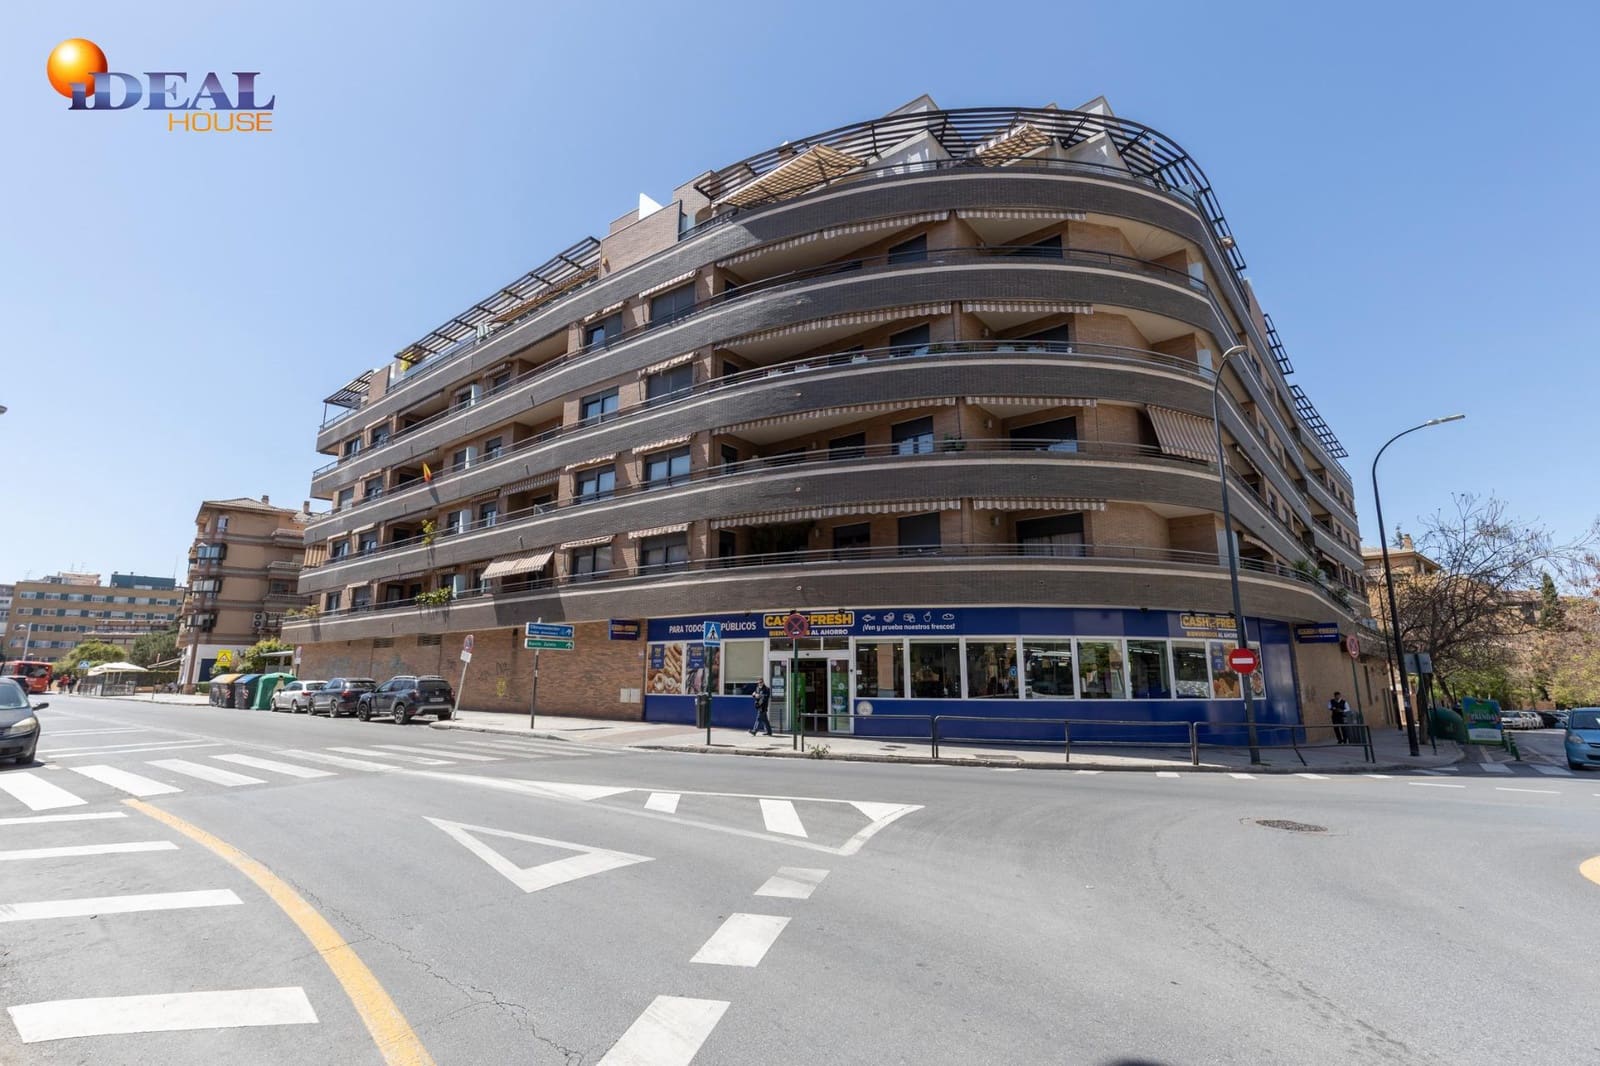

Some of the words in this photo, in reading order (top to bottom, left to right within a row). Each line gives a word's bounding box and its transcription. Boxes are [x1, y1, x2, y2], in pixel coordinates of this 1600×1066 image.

[811, 614, 852, 625] FRESH
[1182, 615, 1209, 627] CASH
[1215, 617, 1237, 628] FRES
[669, 624, 684, 633] PARA
[720, 621, 756, 631] PÚBLICOS
[862, 623, 876, 632] ¡Ven
[881, 624, 903, 632] prueba
[903, 623, 930, 631] nuestros
[931, 622, 956, 630] frescos!
